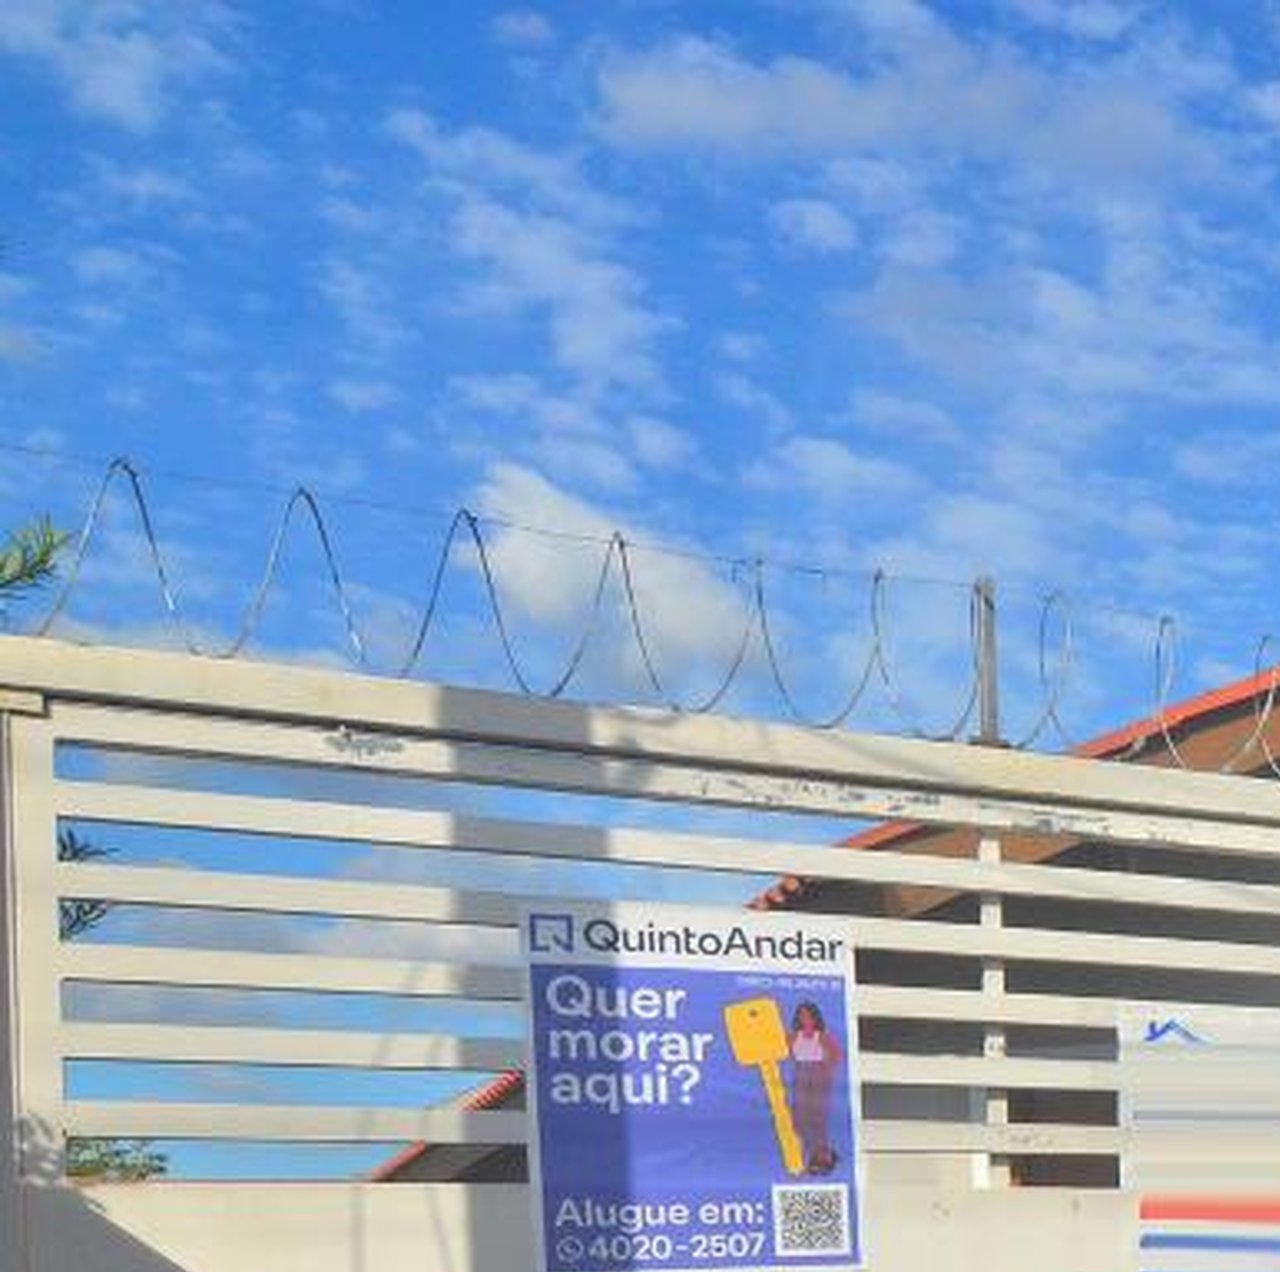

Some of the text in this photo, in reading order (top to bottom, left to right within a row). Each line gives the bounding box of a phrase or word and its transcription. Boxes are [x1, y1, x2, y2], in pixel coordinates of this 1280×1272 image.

[583, 921, 843, 962] QuintoAndar
[546, 975, 686, 1018] Quer
[550, 1028, 714, 1062] morar
[551, 1064, 700, 1114] aqui?
[556, 1200, 765, 1234] Alugue em:
[589, 1234, 765, 1261] 4020-2507
